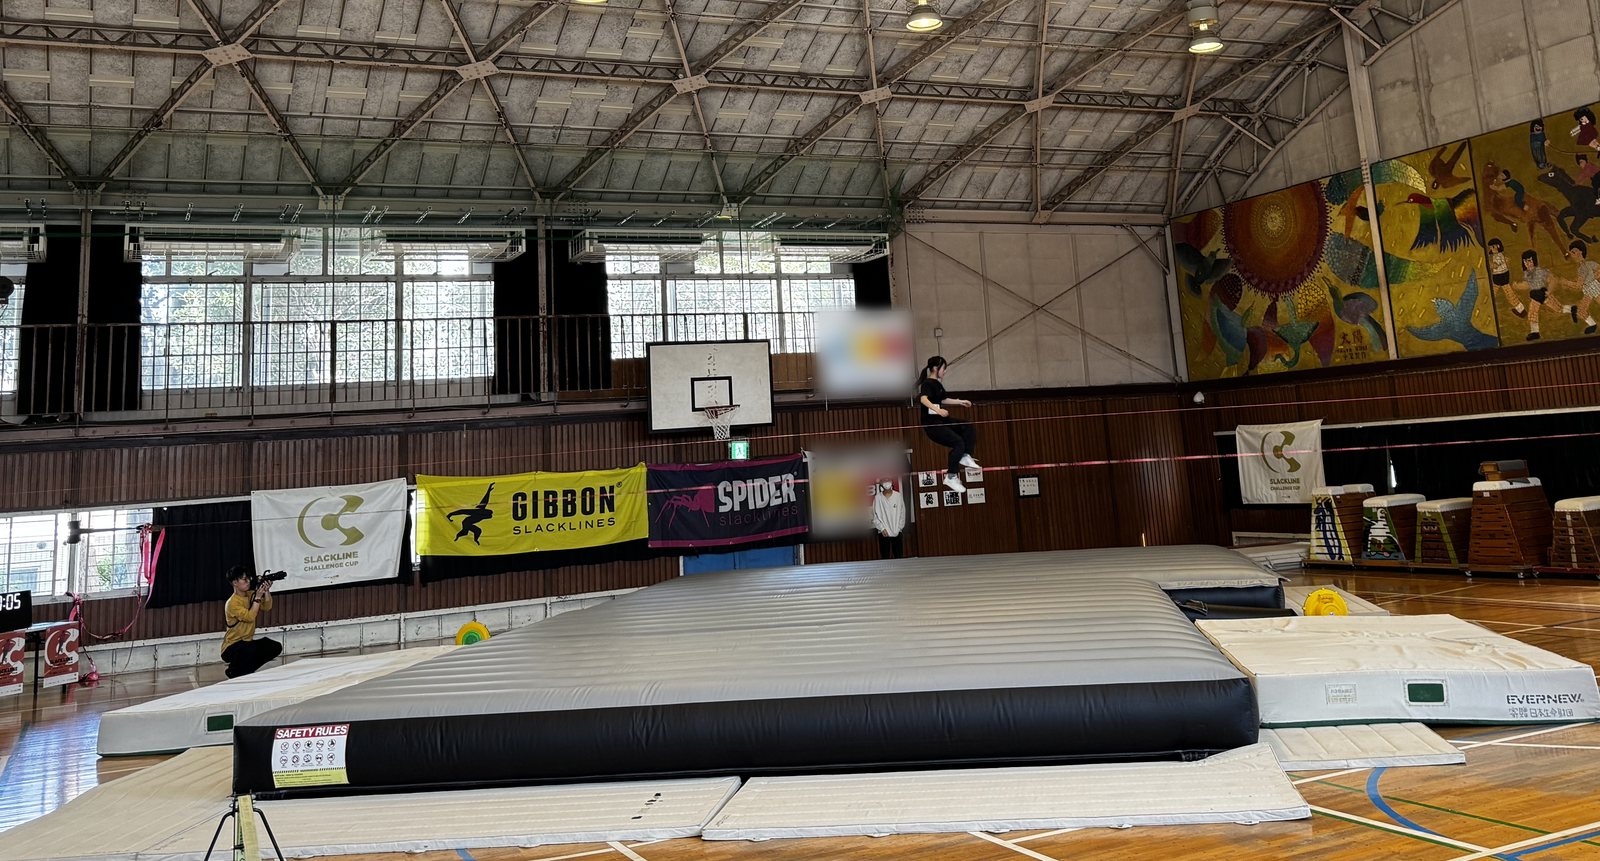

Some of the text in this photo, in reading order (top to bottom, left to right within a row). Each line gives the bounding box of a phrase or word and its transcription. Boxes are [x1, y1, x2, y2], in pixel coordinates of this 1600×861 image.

[717, 473, 796, 513] SPIDER
[512, 485, 615, 521] GIBBON
[719, 505, 798, 527] slacklines
[513, 517, 616, 535] SLACKLINES
[304, 551, 359, 564] SLACKLINE
[304, 562, 344, 572] CHALLENGE
[0, 593, 21, 611] :05
[1506, 693, 1582, 704] EVERNEW
[276, 726, 347, 738] SAFETY RULES
